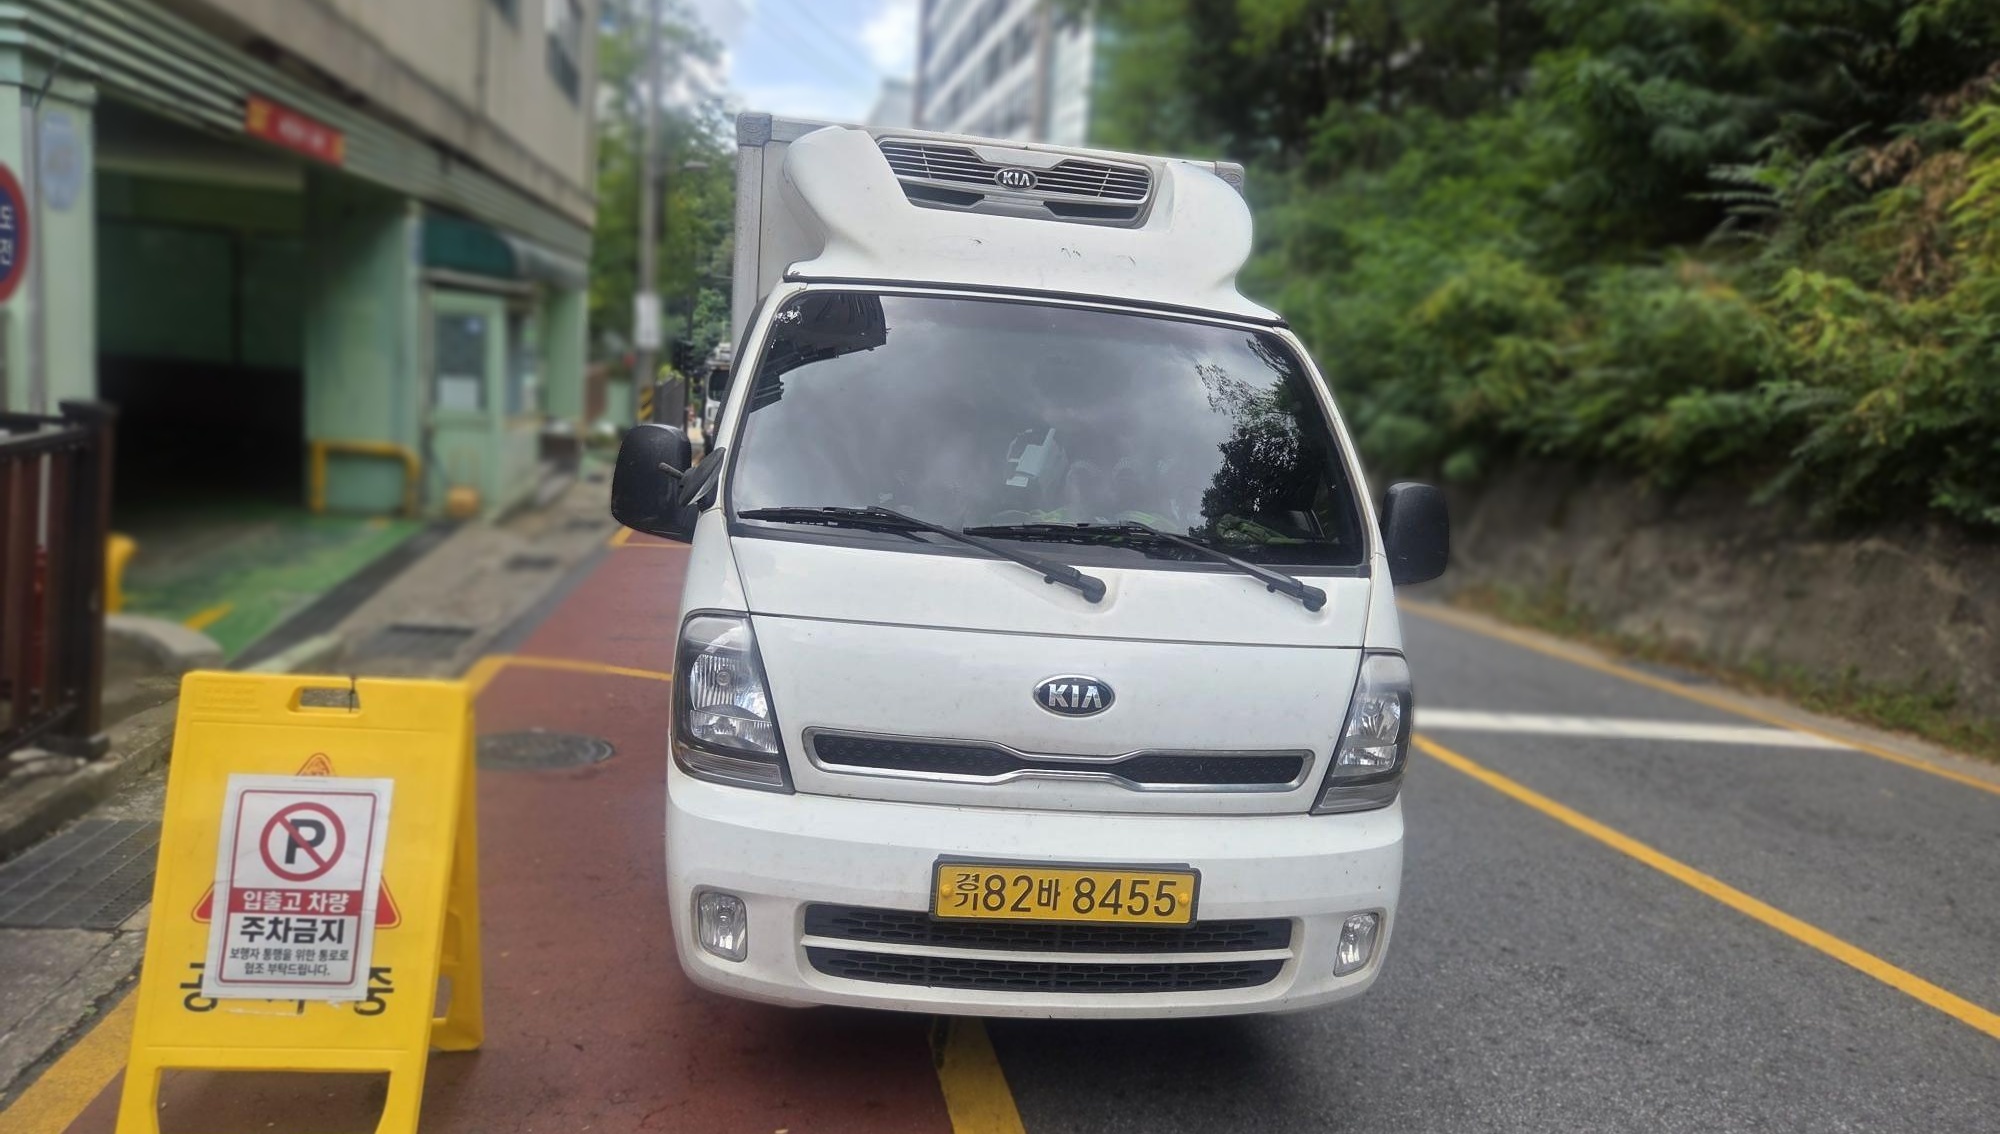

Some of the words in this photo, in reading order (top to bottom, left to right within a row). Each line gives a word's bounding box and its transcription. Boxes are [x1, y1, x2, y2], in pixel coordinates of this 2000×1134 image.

[1002, 171, 1031, 186] KIA
[1048, 683, 1102, 708] KIA
[284, 818, 327, 865] P
[243, 890, 302, 911] 입출고
[306, 892, 350, 913] 차량
[1072, 876, 1177, 917] 8455
[240, 916, 345, 944] 주차금지
[229, 947, 260, 961] 보행자
[262, 948, 293, 961] 통행을
[295, 948, 316, 962] 위한
[318, 949, 349, 962] 통로로
[244, 962, 265, 975] 협조
[267, 963, 331, 976] 부탁드립니다.
